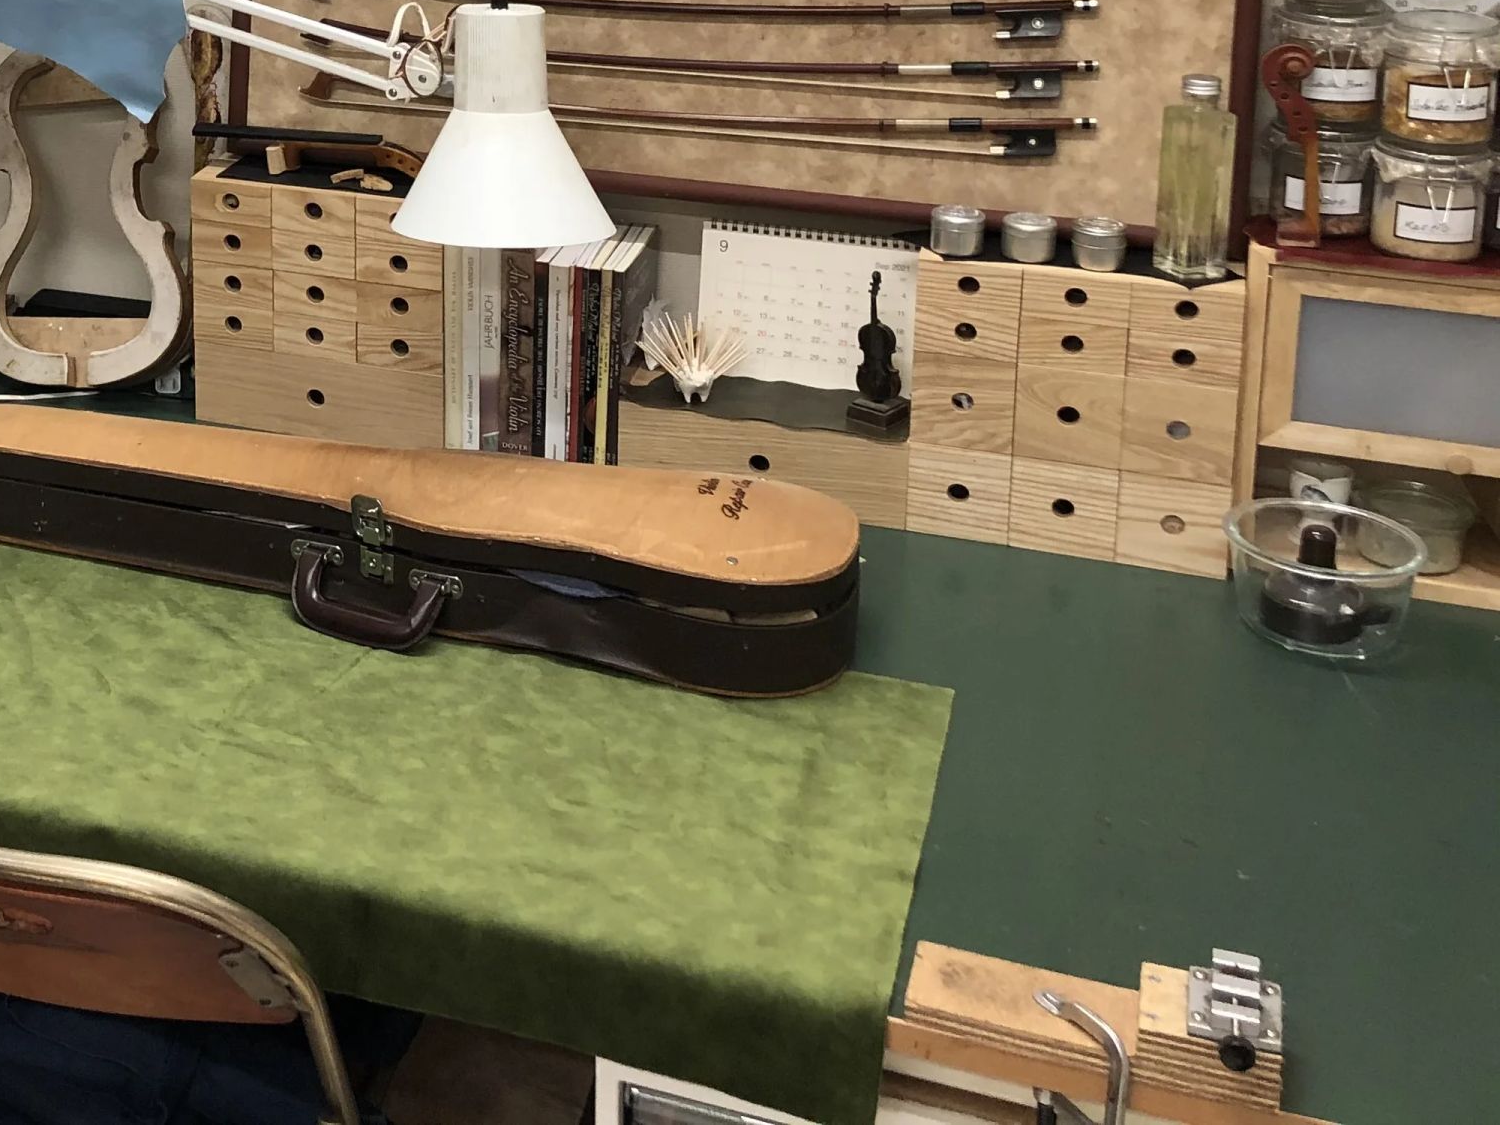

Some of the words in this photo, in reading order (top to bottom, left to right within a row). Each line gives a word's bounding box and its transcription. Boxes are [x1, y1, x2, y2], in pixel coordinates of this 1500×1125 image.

[719, 239, 729, 253] 9
[508, 259, 530, 284] An
[484, 293, 495, 350] JAHRBUCH
[502, 288, 530, 371] Encyclopedia
[507, 394, 529, 433] Violin
